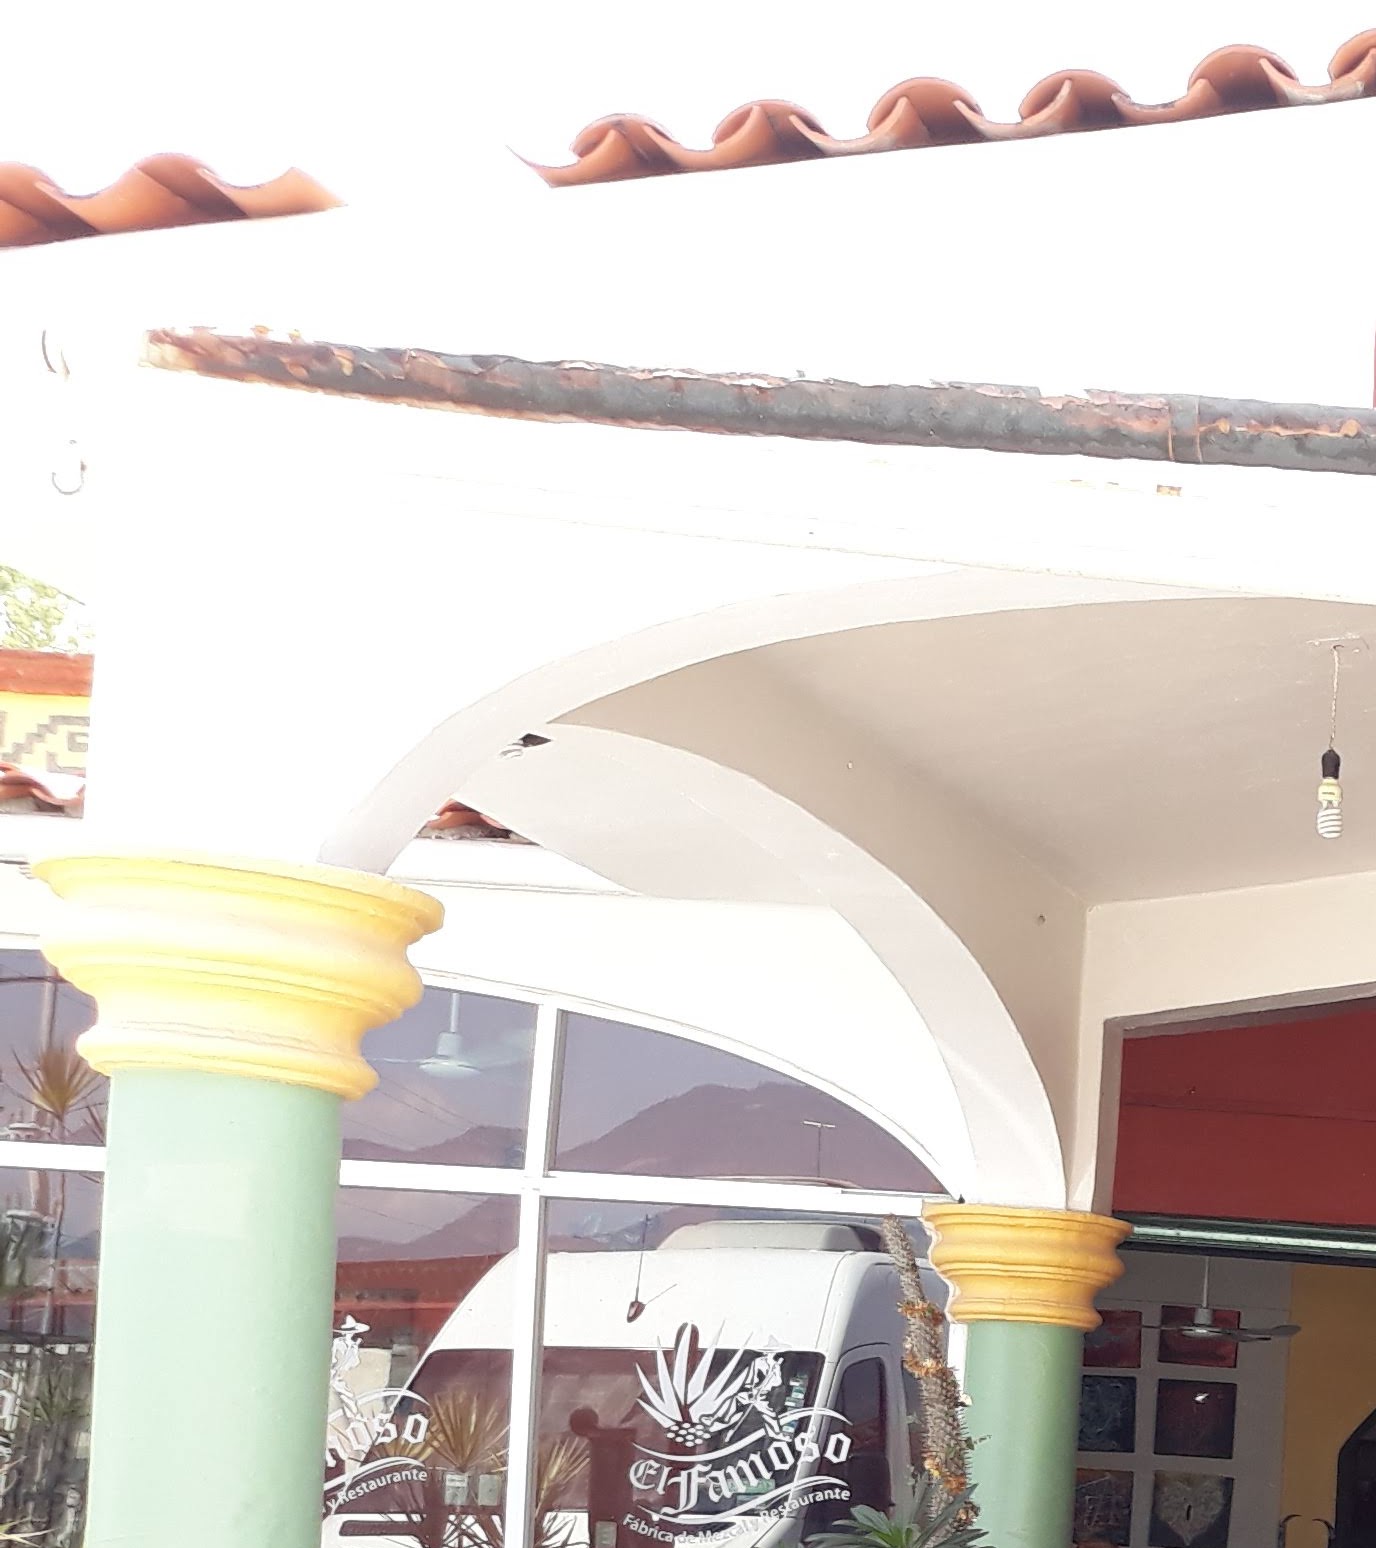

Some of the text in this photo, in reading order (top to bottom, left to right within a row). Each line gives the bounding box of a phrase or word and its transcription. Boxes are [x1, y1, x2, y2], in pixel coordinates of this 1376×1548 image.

[336, 1467, 428, 1506] Restaurante
[628, 1432, 852, 1515] El Famoso
[622, 1513, 675, 1543] Fábrica
[677, 1530, 696, 1544] de
[758, 1487, 851, 1524] Restaurante
